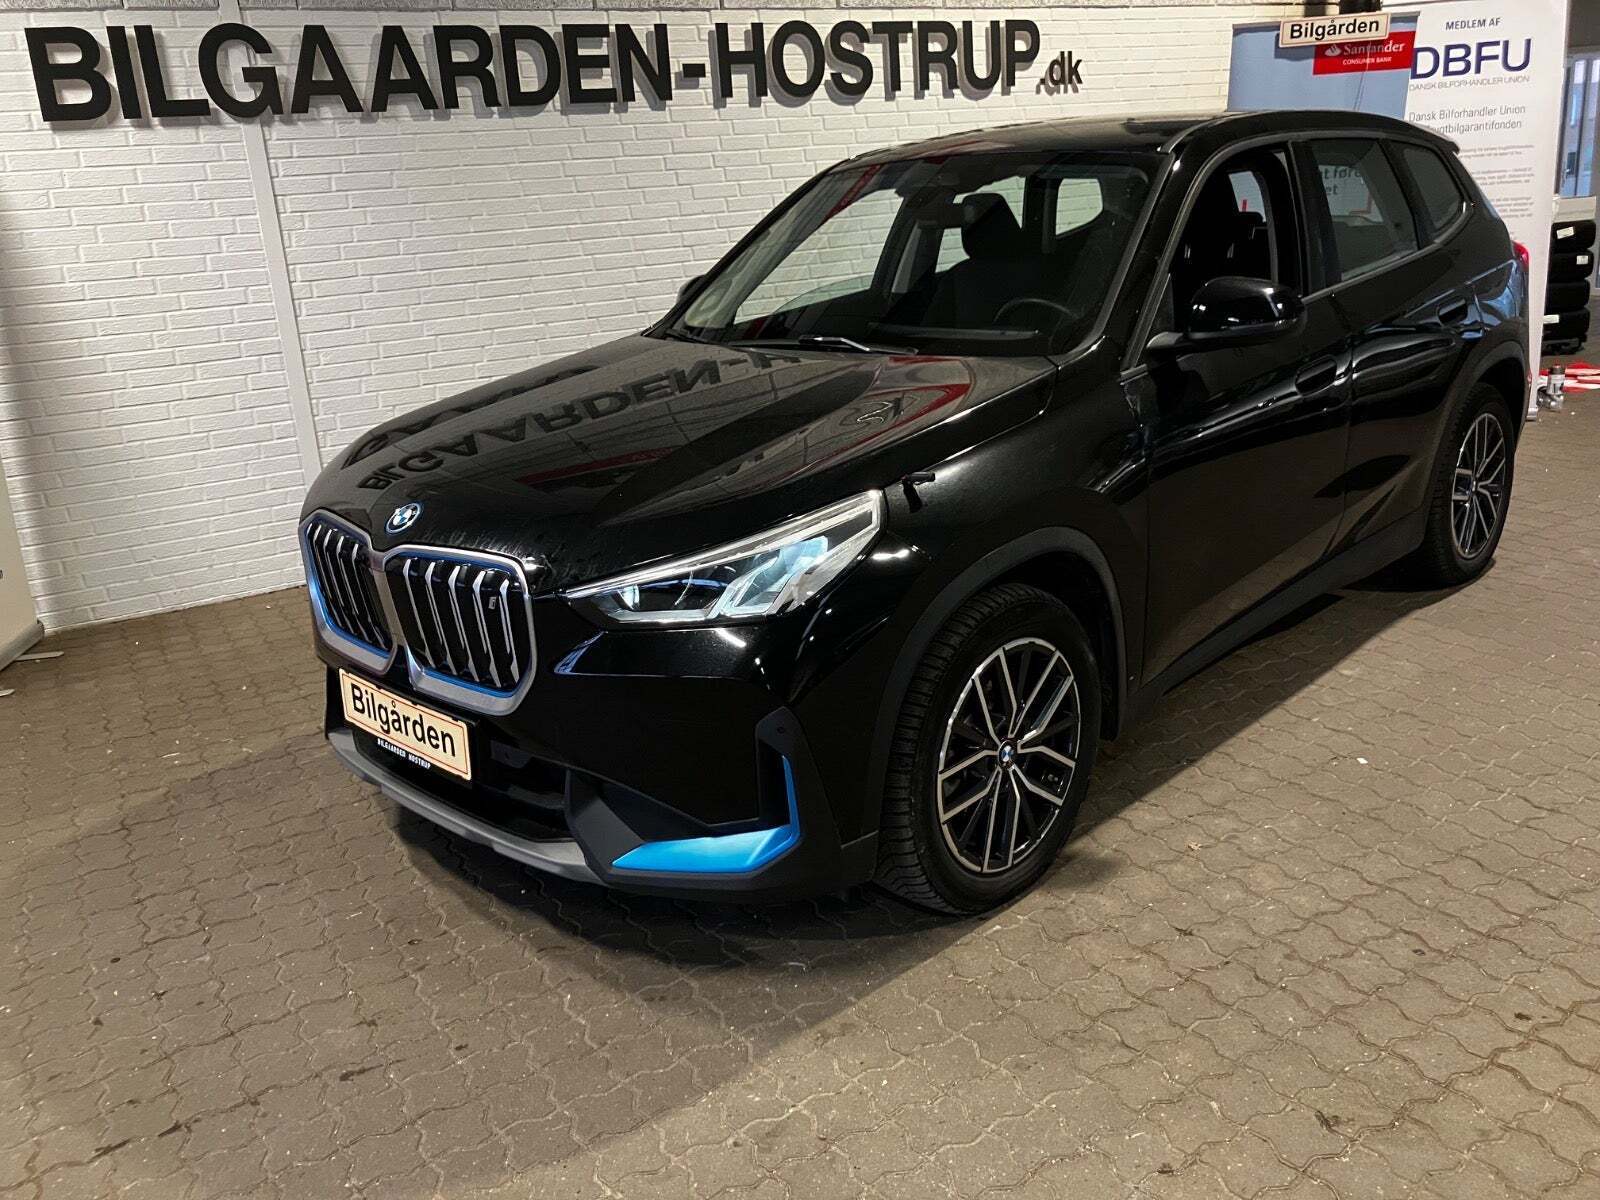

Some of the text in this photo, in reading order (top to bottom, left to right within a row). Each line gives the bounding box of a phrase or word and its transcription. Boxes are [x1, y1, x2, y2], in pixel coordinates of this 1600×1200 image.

[1289, 19, 1380, 41] Bilgården
[1445, 17, 1501, 31] MEDLEM AF
[1343, 41, 1405, 57] Santander
[1342, 56, 1393, 66] CONSUMER BANK
[1410, 38, 1532, 79] DBFU
[1409, 83, 1438, 92] DANSK
[1504, 75, 1530, 84] UNION
[1408, 104, 1526, 122] Dansk Bilforhandler Union
[350, 683, 456, 757] Bilgården
